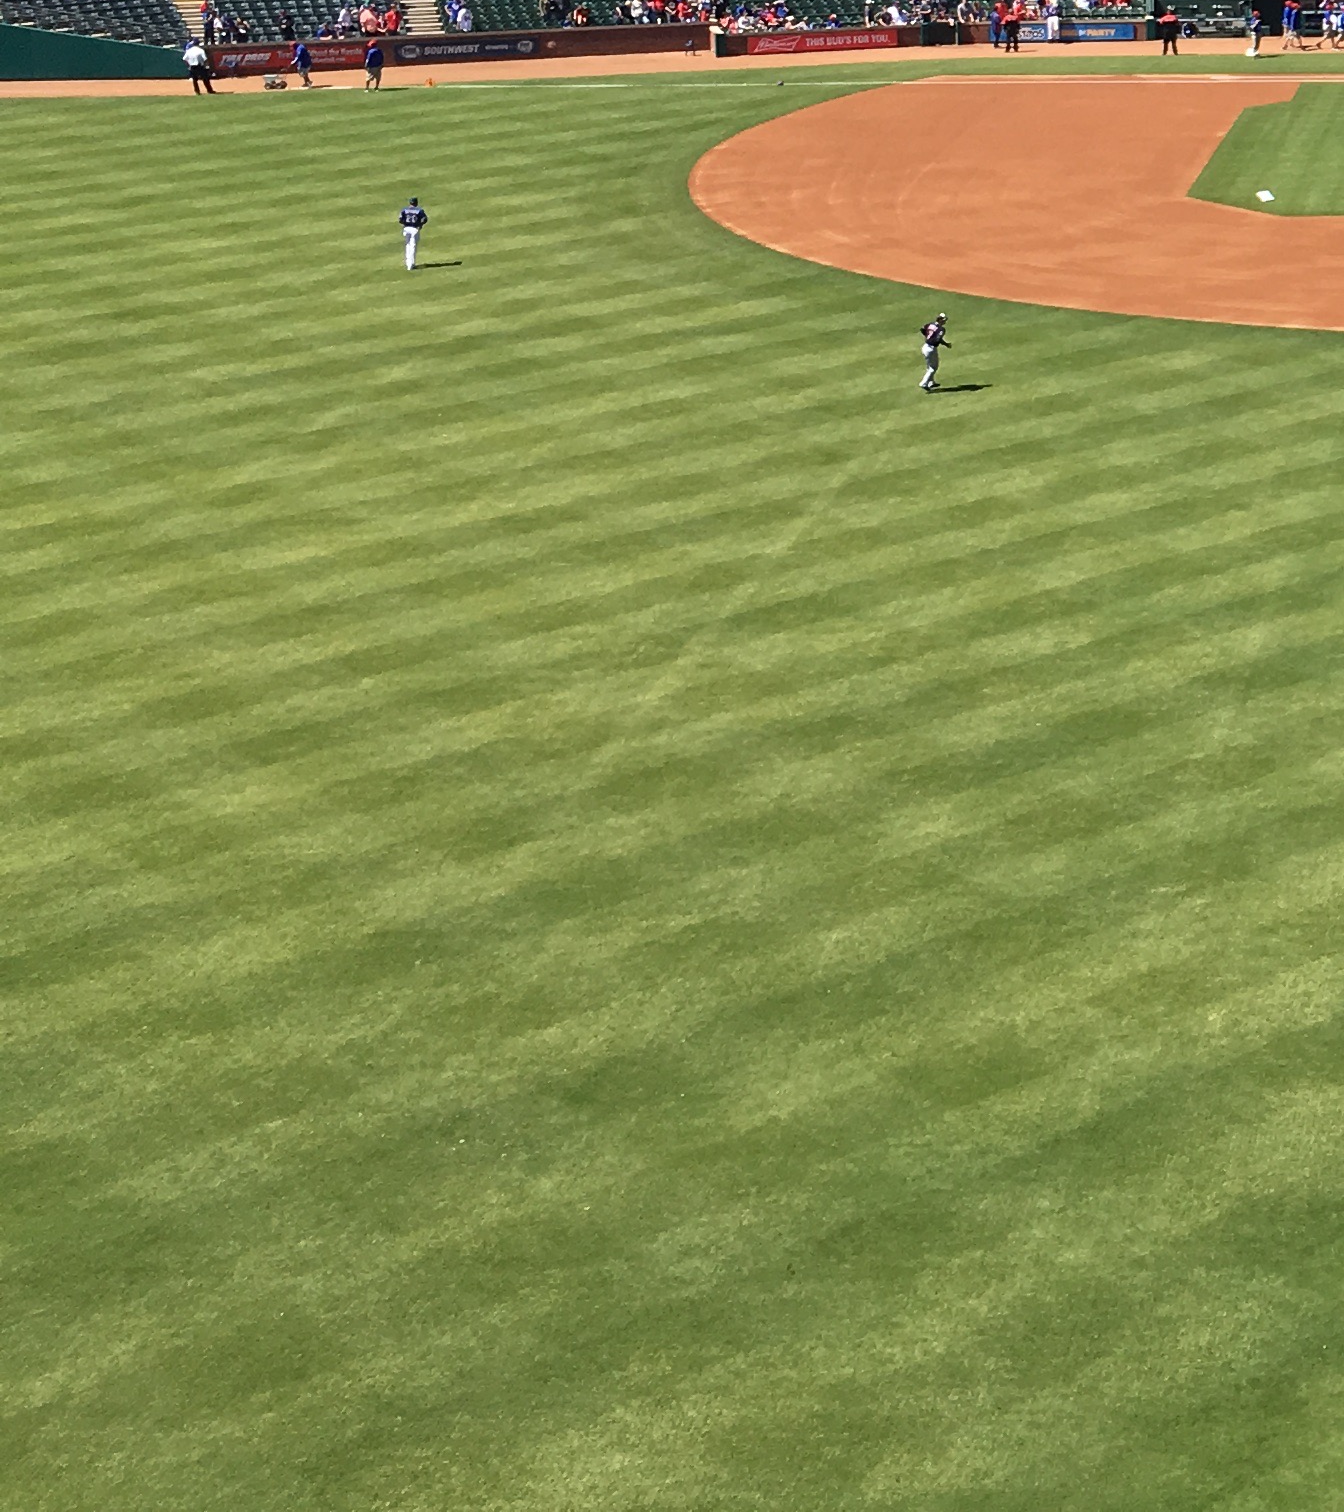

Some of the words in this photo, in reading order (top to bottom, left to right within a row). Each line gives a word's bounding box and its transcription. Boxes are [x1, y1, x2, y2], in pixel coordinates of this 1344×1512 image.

[806, 37, 825, 47] THIS
[853, 35, 869, 44] FOR
[424, 44, 480, 55] SOUTHWEST
